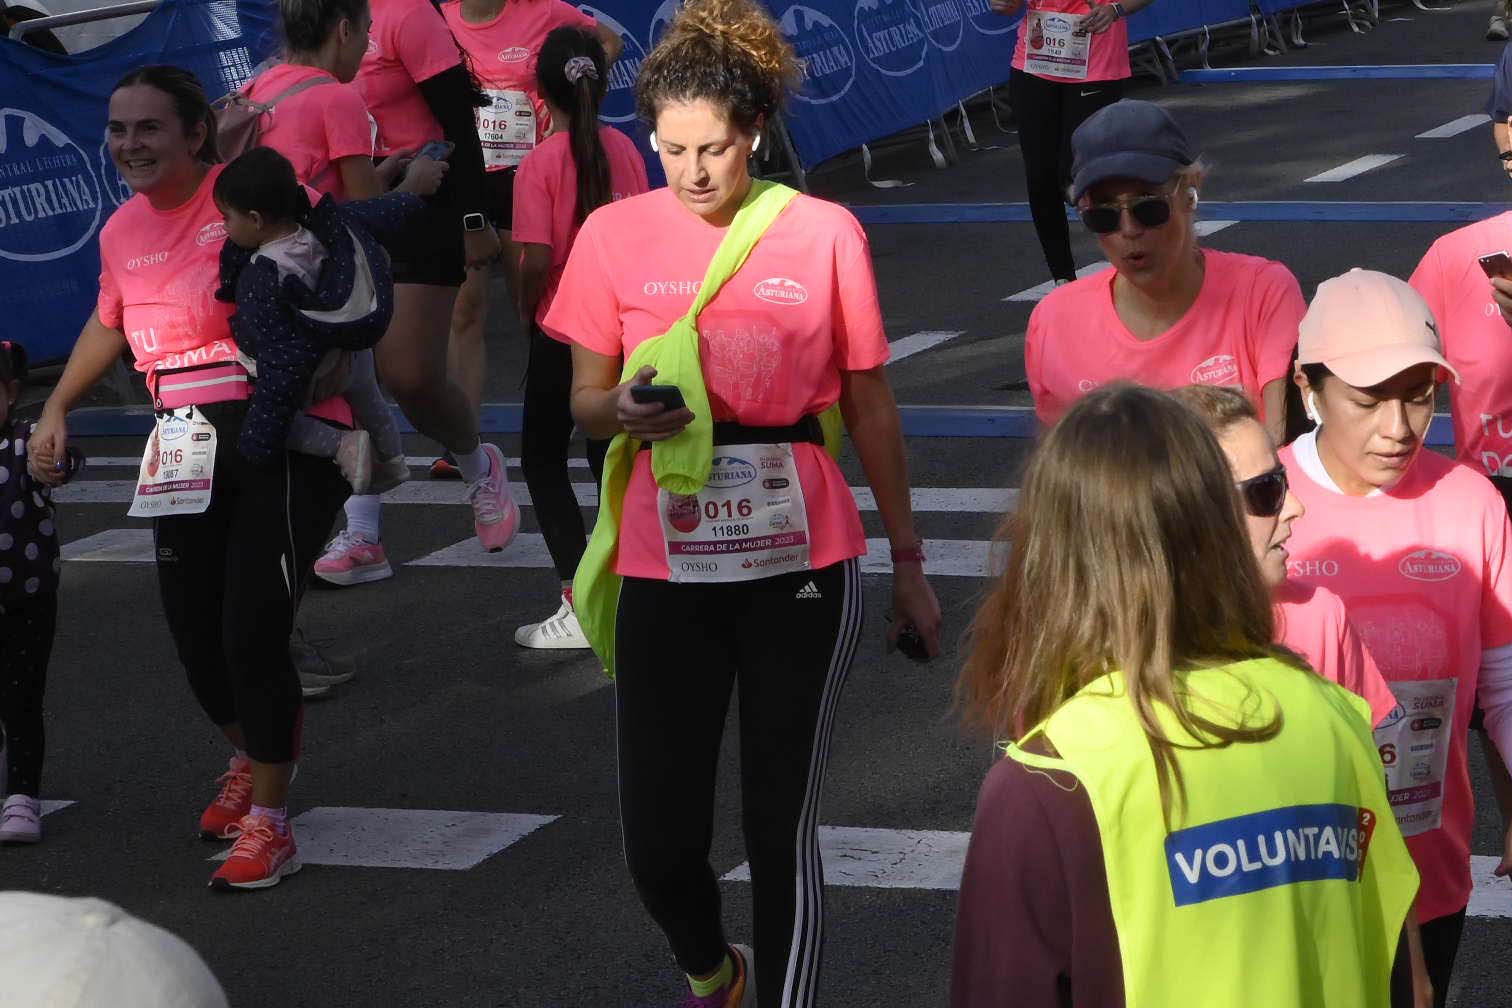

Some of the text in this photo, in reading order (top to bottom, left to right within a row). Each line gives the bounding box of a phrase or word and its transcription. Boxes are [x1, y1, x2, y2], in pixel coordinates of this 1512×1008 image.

[1045, 36, 1066, 48] 016
[482, 118, 508, 131] 016
[127, 251, 168, 271] OYSHO
[758, 286, 805, 301] ASTURIANA
[131, 327, 158, 353] TU
[161, 448, 183, 466] 016
[760, 461, 785, 470] SUMA
[704, 498, 753, 520] 016
[711, 523, 749, 538] 11880
[681, 543, 715, 552] CARRERA
[716, 543, 727, 551] DE
[729, 542, 740, 550] LA
[742, 538, 772, 549] MUJER
[681, 552, 800, 574] OYSHO Santander
[1404, 562, 1457, 575] ASTURIANA
[796, 590, 823, 600] adidas
